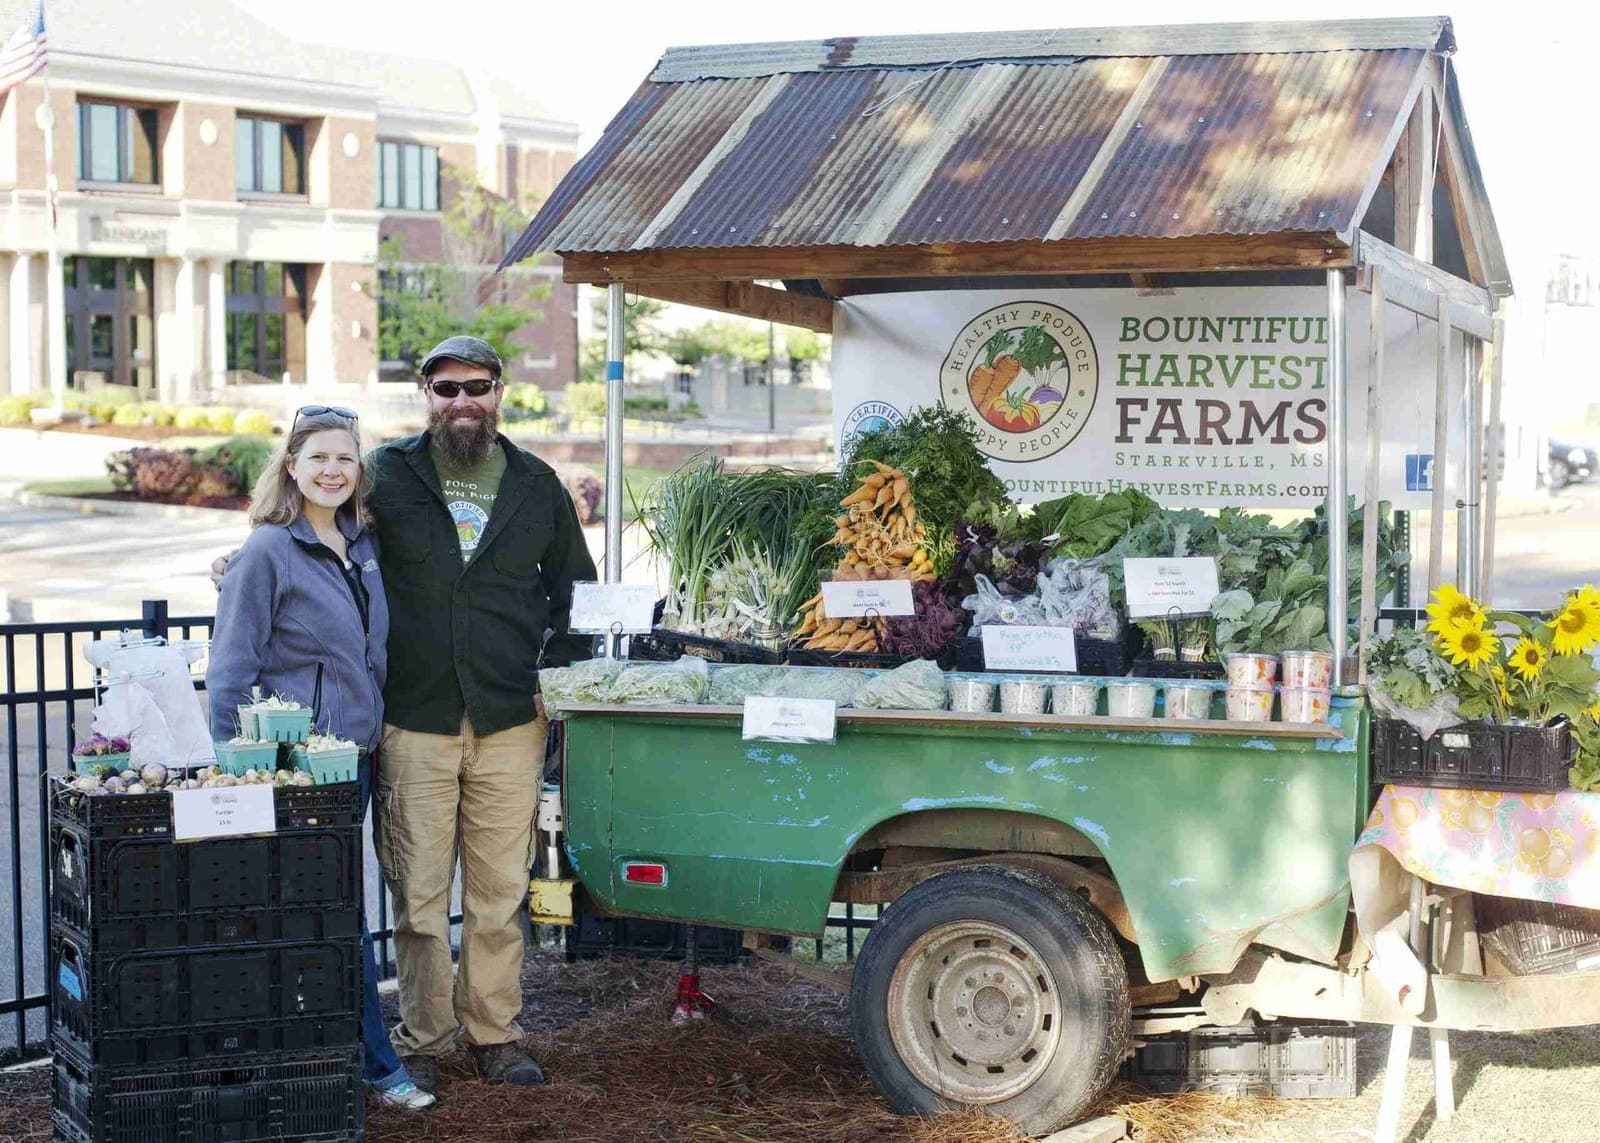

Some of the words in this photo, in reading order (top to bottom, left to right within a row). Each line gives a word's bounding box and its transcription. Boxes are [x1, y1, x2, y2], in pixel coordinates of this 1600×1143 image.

[951, 310, 1020, 372] HEALTHY
[1031, 310, 1090, 373] PRODUCE
[1119, 316, 1328, 344] BOUNTIFUL
[1115, 354, 1328, 390] HARVEST
[1019, 408, 1078, 453] PEOPLE
[1115, 398, 1327, 445] FARMS
[1291, 453, 1323, 467] MS
